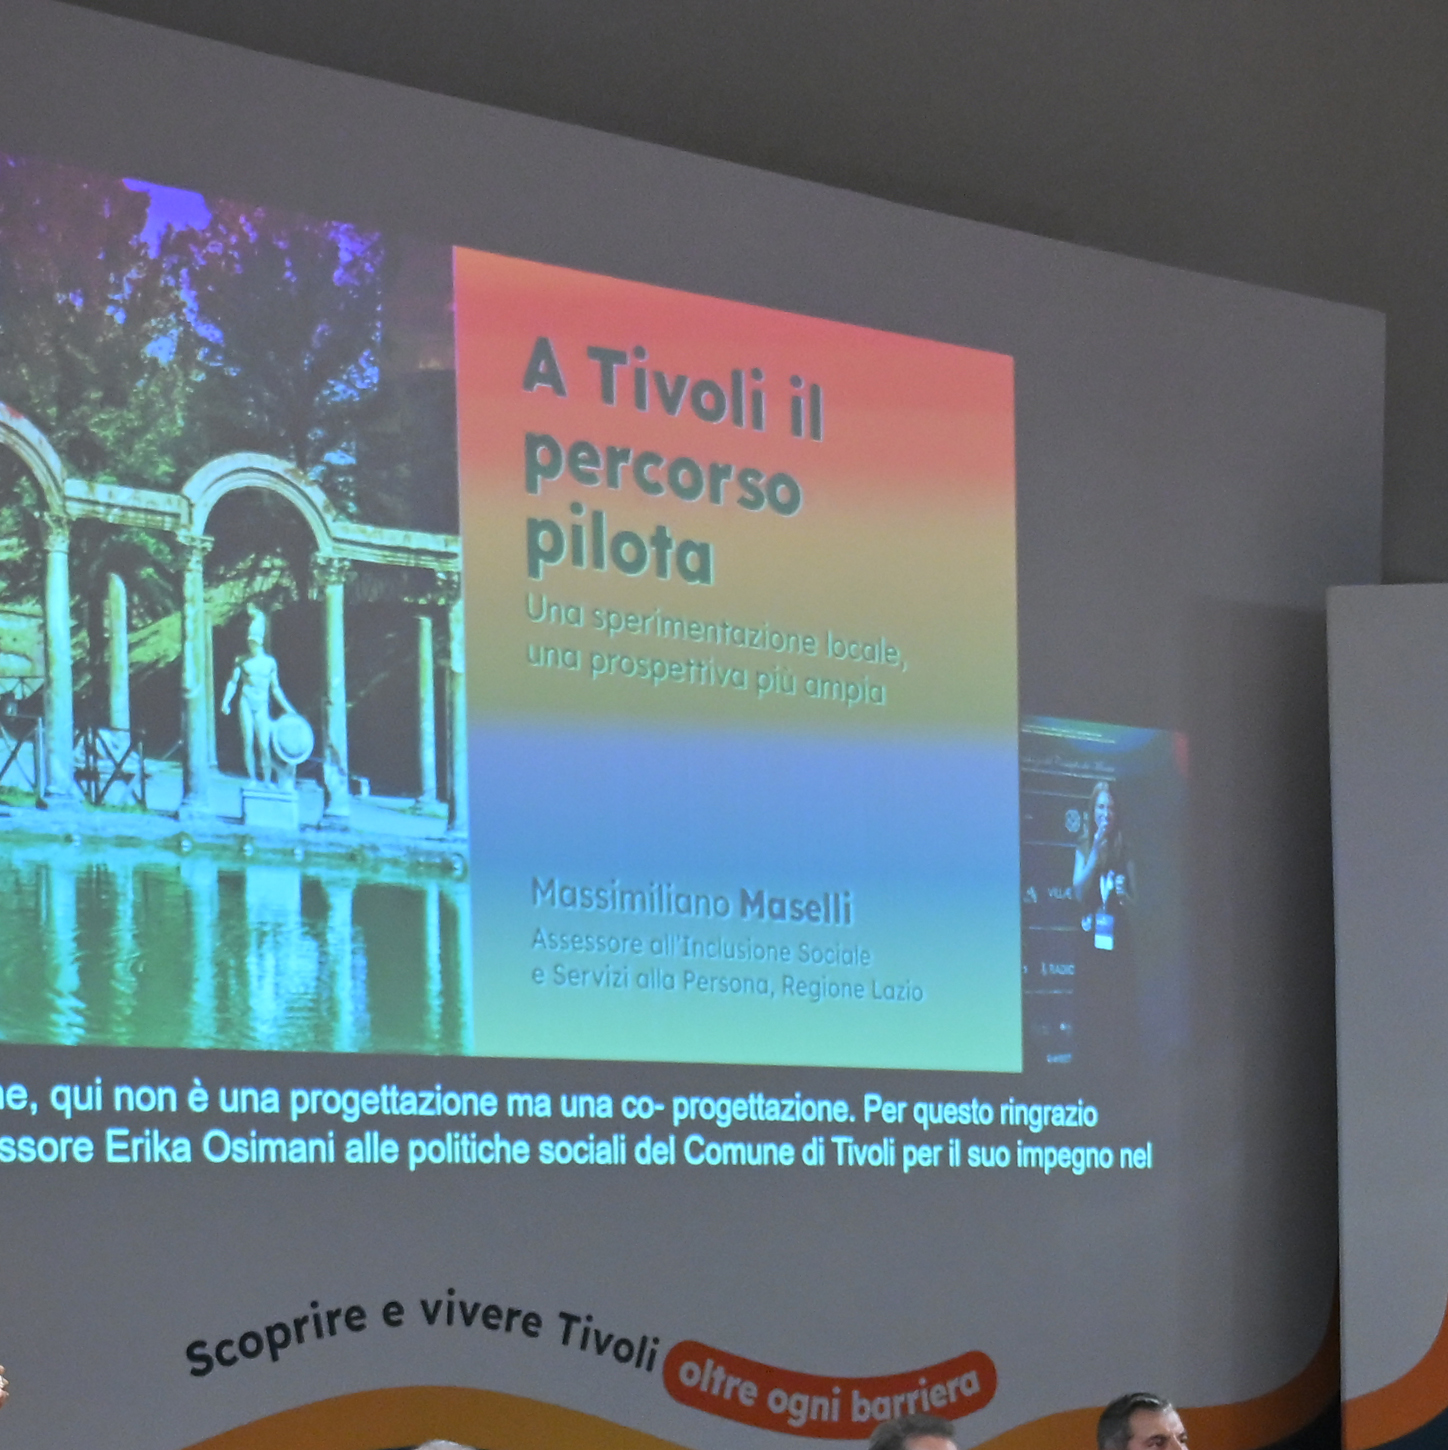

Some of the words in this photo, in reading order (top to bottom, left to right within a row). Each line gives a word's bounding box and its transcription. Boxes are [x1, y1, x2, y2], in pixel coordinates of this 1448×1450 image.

[522, 335, 568, 398] A
[587, 345, 766, 432] Tivoli
[790, 374, 824, 443] il
[524, 431, 803, 517] percorso
[526, 500, 715, 586] pilota
[527, 592, 584, 627] Una
[593, 607, 817, 657] sperimentazione
[827, 630, 908, 673] locale,
[528, 643, 581, 670] una
[591, 649, 748, 691] prospettiva
[756, 666, 797, 699] più
[804, 675, 887, 708] ampia
[532, 876, 730, 918] Massimiliano
[739, 887, 852, 925] Maselli
[532, 927, 643, 955] Assessore
[650, 934, 791, 963] all'Inclusione
[797, 943, 871, 966] Sociale
[532, 967, 544, 985] e
[553, 963, 630, 989] Servizi
[636, 968, 675, 991] alla
[683, 970, 776, 1000] Persona,
[782, 975, 865, 1003] Regione
[872, 981, 923, 1002] Lazio
[50, 1077, 103, 1118] qui
[114, 1085, 177, 1112] non
[188, 1079, 209, 1113] è
[219, 1085, 280, 1114] una
[290, 1082, 498, 1122] progettazione
[507, 1095, 550, 1119] ma
[561, 1095, 614, 1120] una
[621, 1094, 664, 1121] co-
[672, 1092, 855, 1128] progettazione.
[863, 1093, 906, 1124] Per
[913, 1098, 993, 1129] questo
[1001, 1095, 1100, 1132] ringrazio
[106, 1127, 192, 1163] Erika
[203, 1130, 335, 1164] Osimani
[345, 1131, 399, 1164] alle
[408, 1132, 530, 1171] politiche
[539, 1132, 627, 1167] sociali
[635, 1134, 676, 1166] del
[684, 1135, 794, 1167] Comune
[802, 1135, 824, 1167] di
[831, 1135, 895, 1168] Tivoli
[903, 1143, 941, 1174] per
[948, 1138, 961, 1167] il
[967, 1145, 1011, 1168] suo
[1017, 1139, 1113, 1175] impegno
[1119, 1141, 1153, 1170] nel
[185, 1300, 368, 1377] Scoprire
[382, 1299, 405, 1327] e
[419, 1286, 544, 1338] vivere
[557, 1310, 661, 1373] Tivoli
[679, 1358, 758, 1406] oltre
[767, 1385, 841, 1427] ogni
[851, 1370, 981, 1423] barriera
